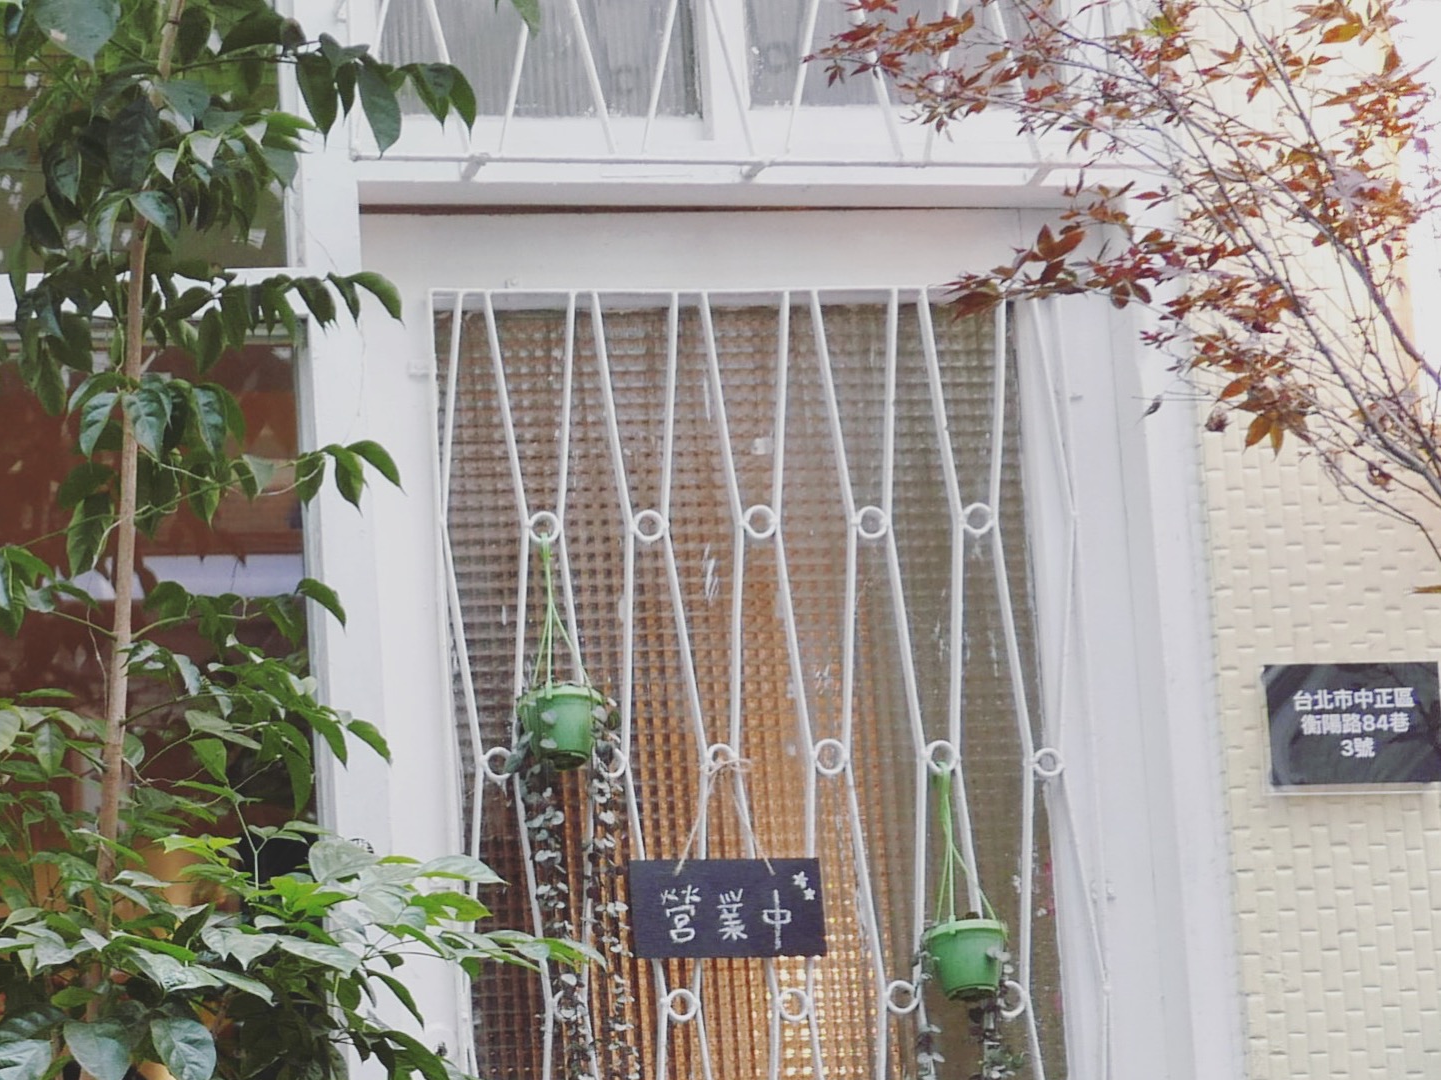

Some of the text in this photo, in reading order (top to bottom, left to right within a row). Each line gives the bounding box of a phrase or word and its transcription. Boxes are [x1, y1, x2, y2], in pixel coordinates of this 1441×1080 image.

[1293, 687, 1415, 711] 台北市中正區
[1301, 712, 1410, 735] 衡陽路84巷
[1340, 737, 1375, 758] 3號
[661, 884, 791, 950] 營業中
